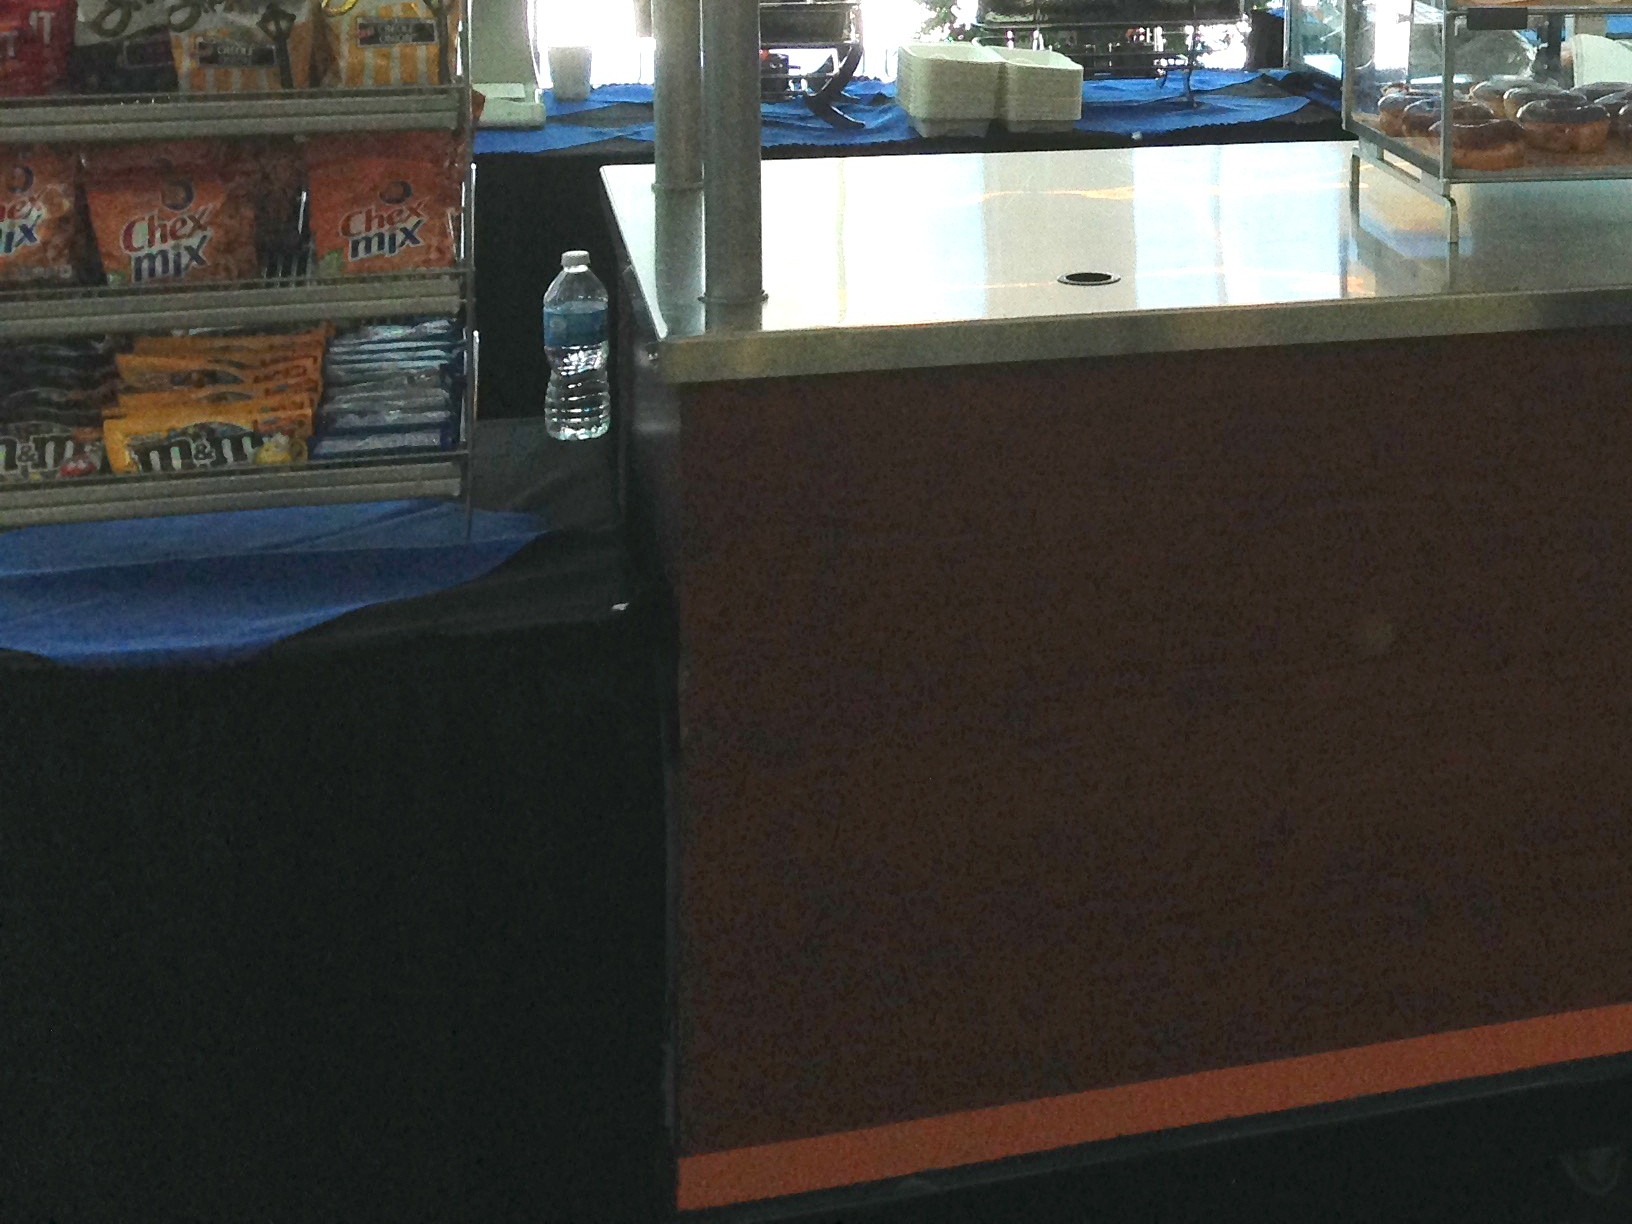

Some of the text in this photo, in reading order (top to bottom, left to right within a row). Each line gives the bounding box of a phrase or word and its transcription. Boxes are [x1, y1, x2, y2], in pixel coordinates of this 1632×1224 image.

[120, 200, 222, 254] Chex
[340, 197, 430, 238] Chex
[348, 218, 425, 261] mix
